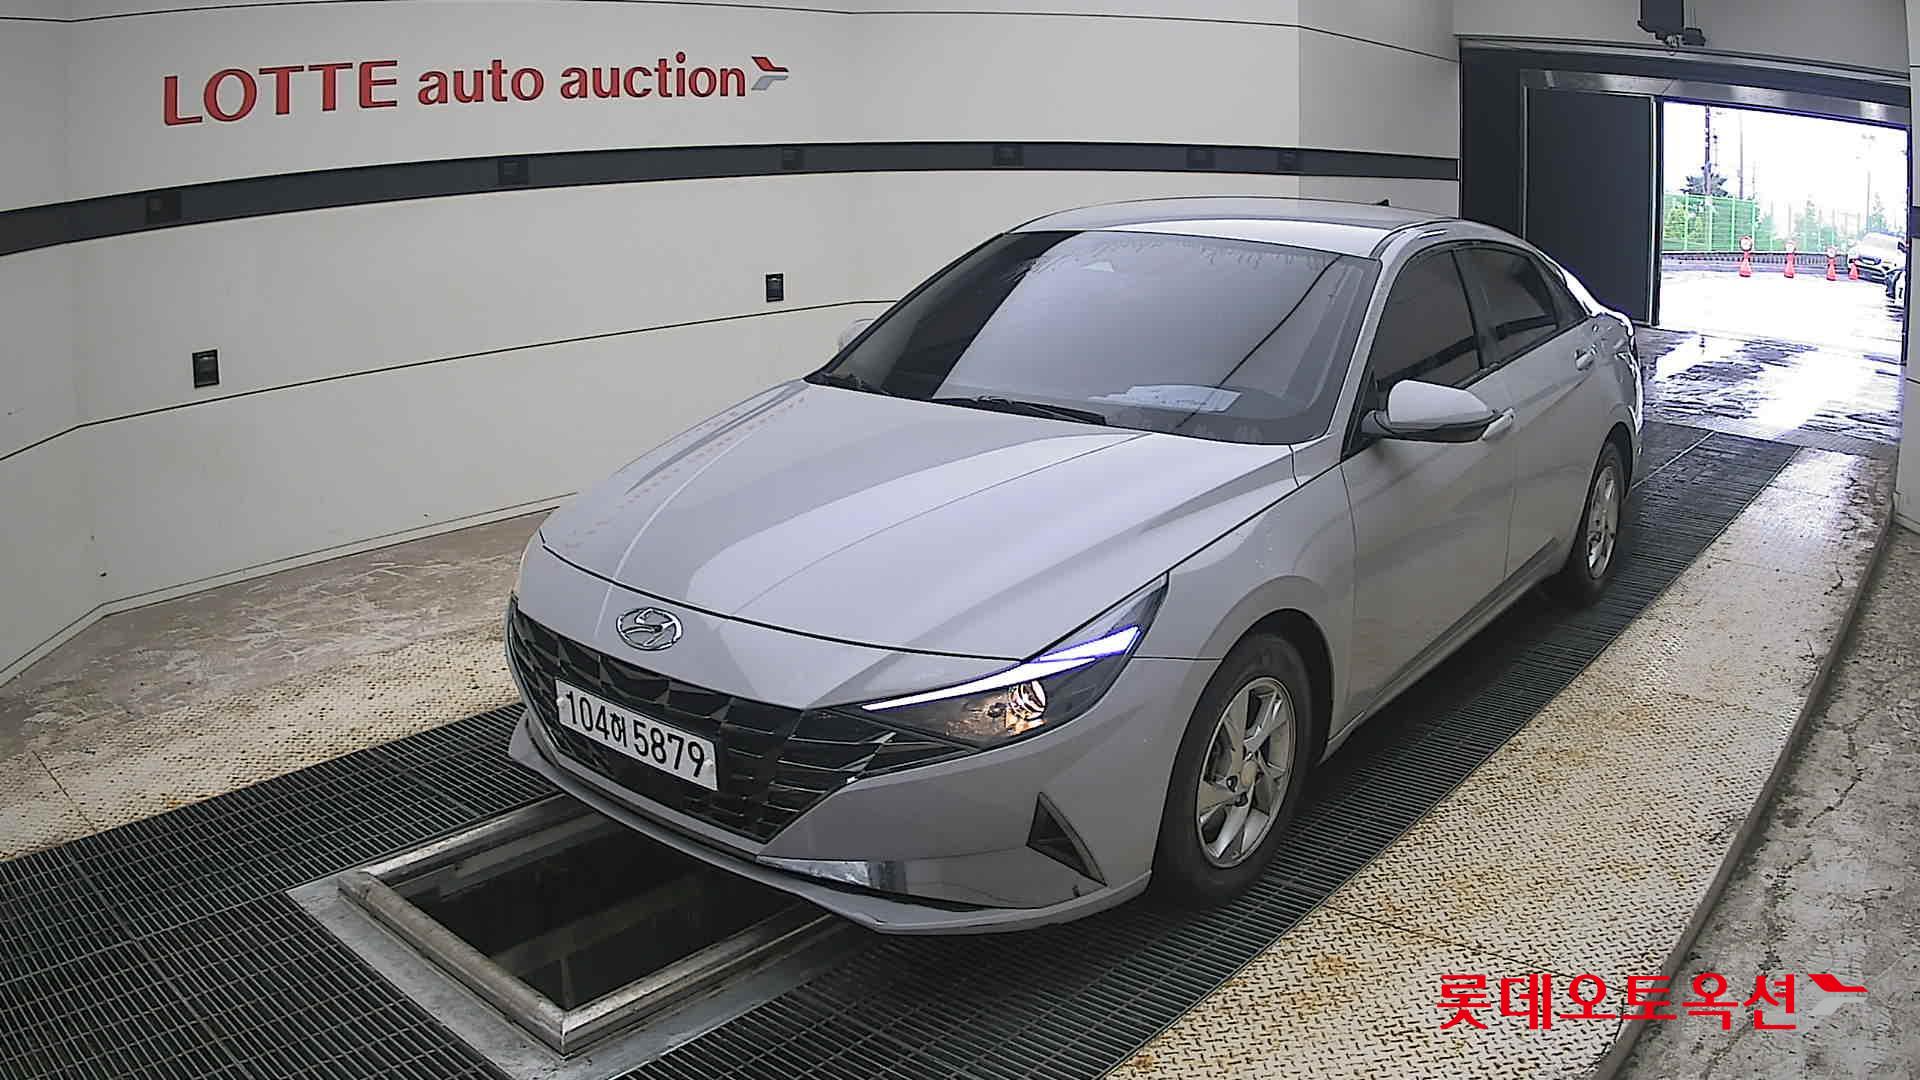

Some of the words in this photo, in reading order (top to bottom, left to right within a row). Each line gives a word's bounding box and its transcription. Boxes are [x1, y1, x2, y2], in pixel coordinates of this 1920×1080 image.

[163, 60, 398, 127] LOTTE
[417, 58, 545, 106] auto
[560, 51, 747, 101] auction
[633, 719, 705, 778] 5879
